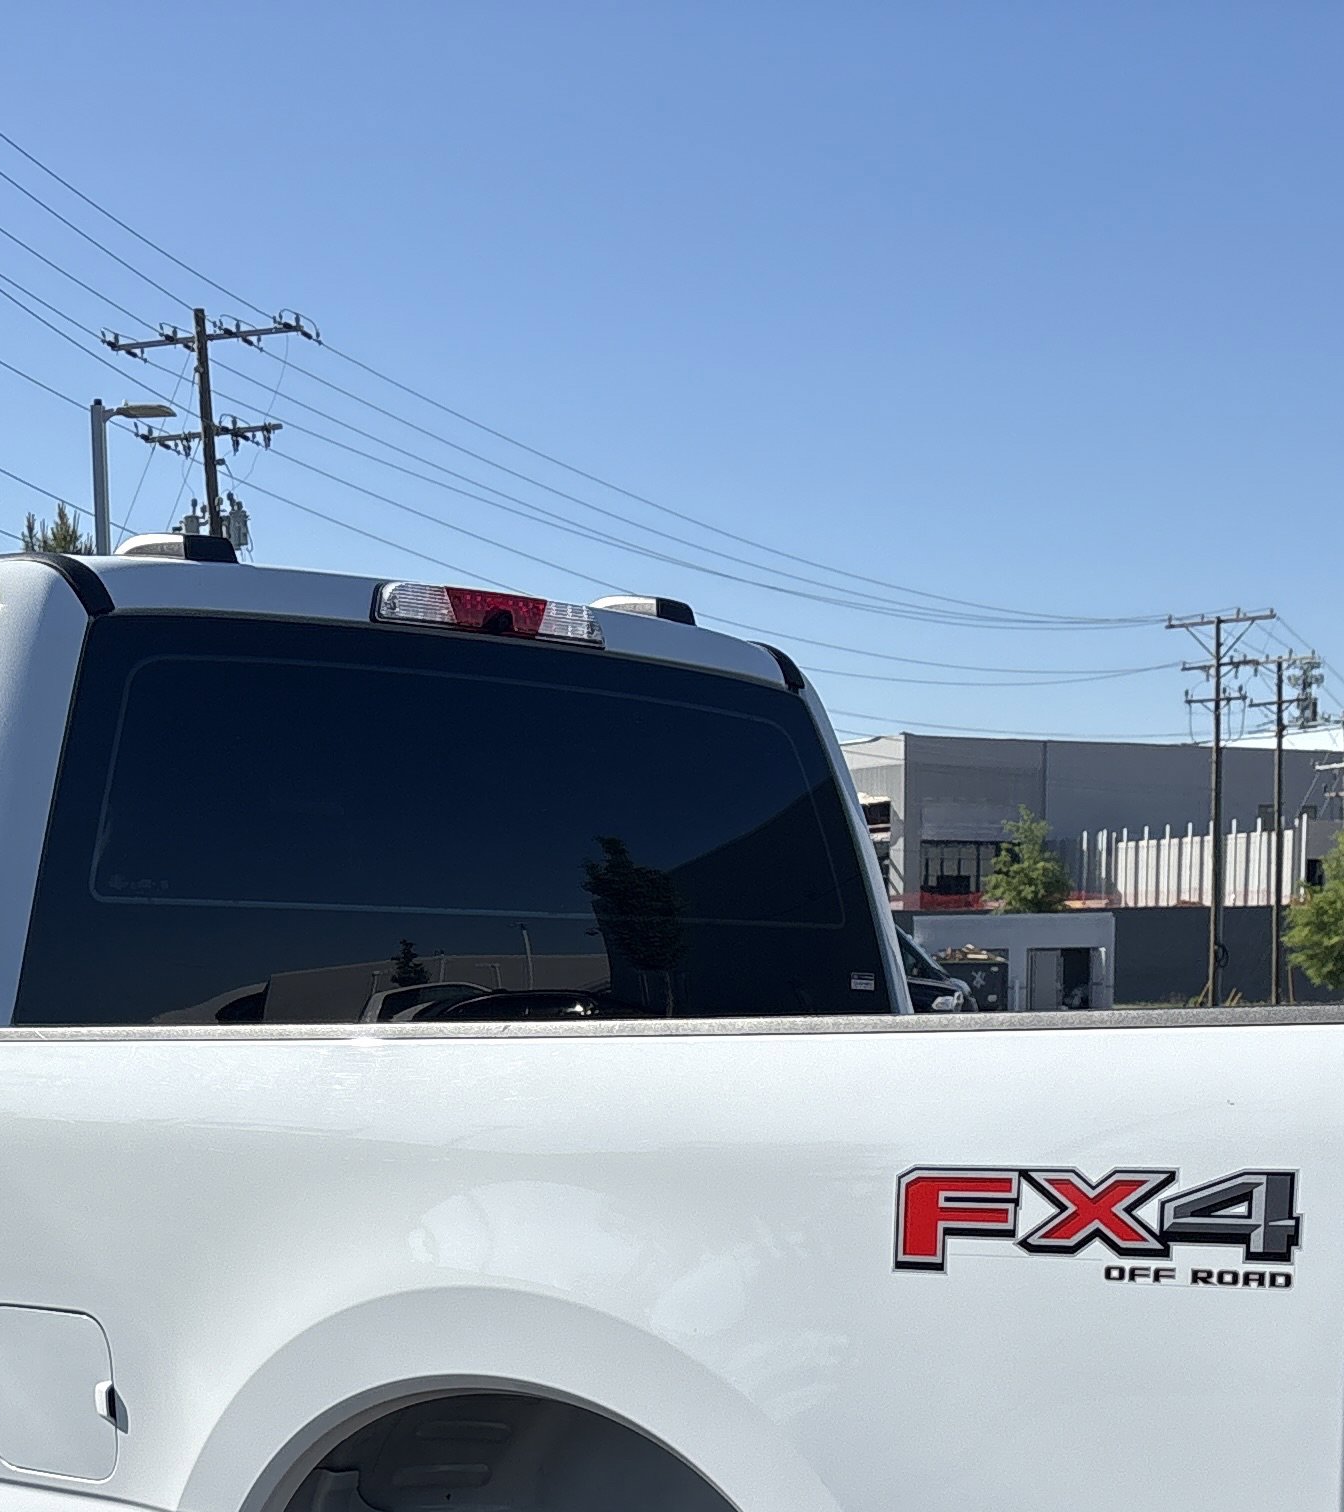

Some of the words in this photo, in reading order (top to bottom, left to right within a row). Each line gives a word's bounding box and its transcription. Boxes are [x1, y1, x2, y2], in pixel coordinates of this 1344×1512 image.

[892, 1165, 1303, 1274] FX4
[1104, 1264, 1177, 1284] OFF
[1190, 1268, 1293, 1290] ROAD
